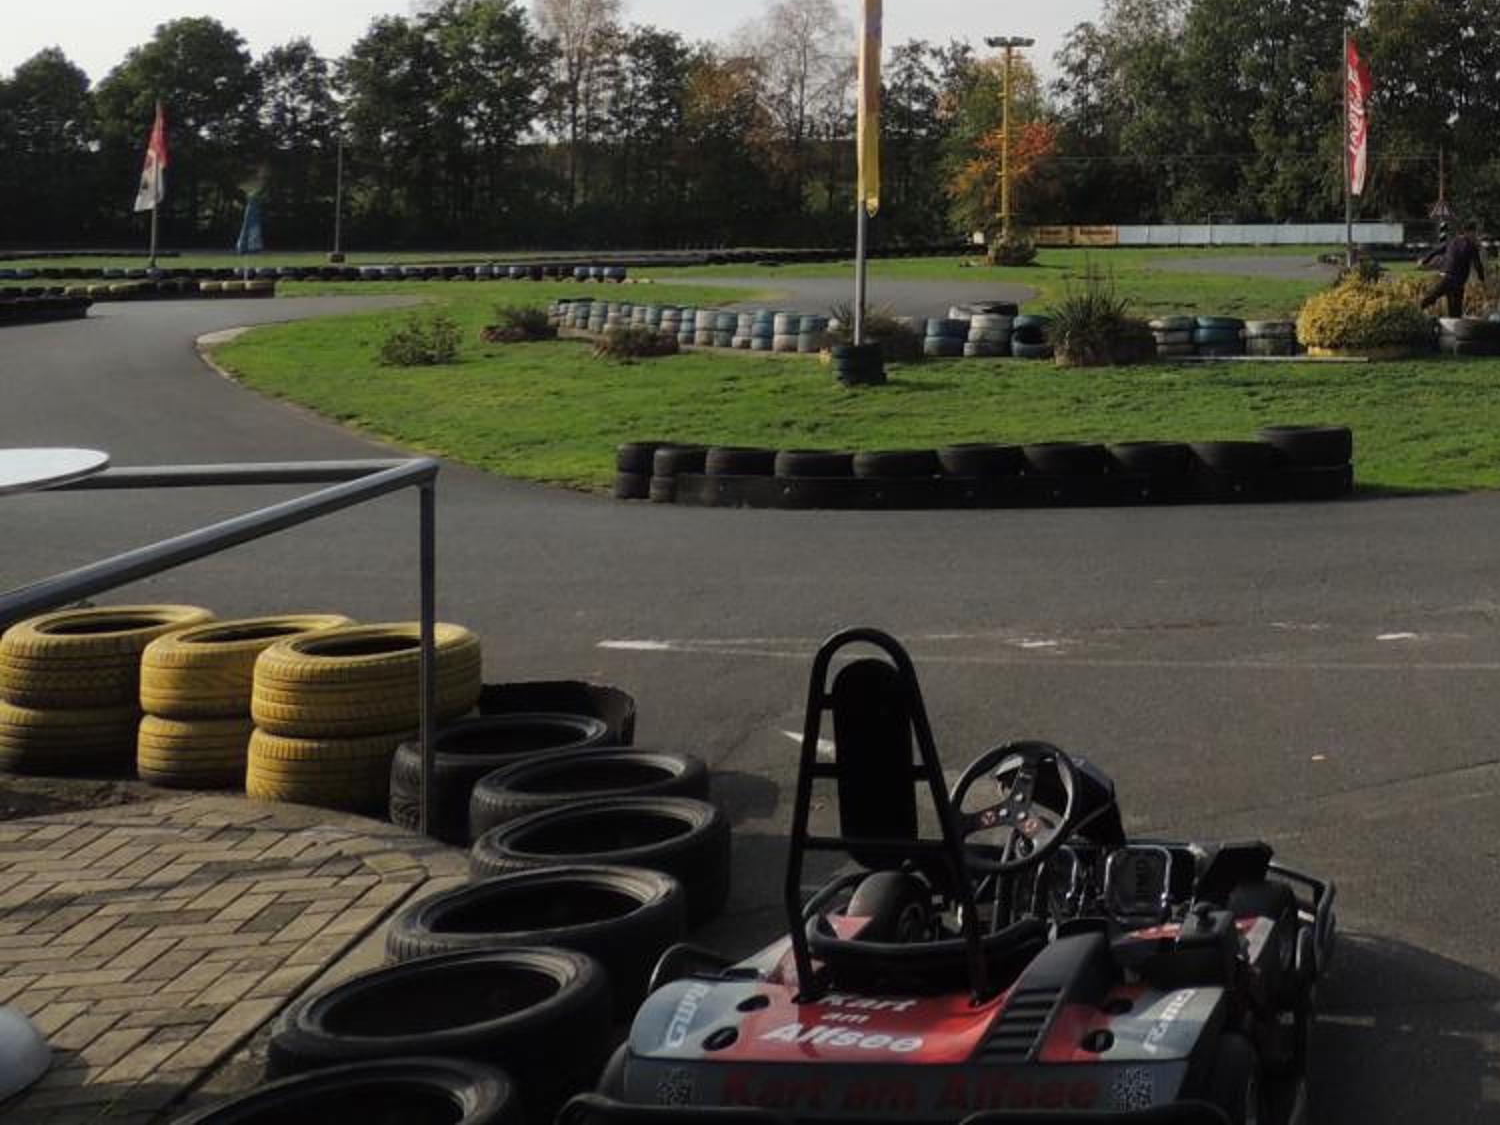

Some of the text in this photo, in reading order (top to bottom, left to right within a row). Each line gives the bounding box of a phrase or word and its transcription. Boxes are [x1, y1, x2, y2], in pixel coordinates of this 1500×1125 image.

[818, 994, 917, 1011] Kart
[821, 1013, 870, 1023] am
[760, 1023, 923, 1052] Alfsee
[721, 1072, 826, 1107] Kart
[931, 1072, 1098, 1110] Alfsee
